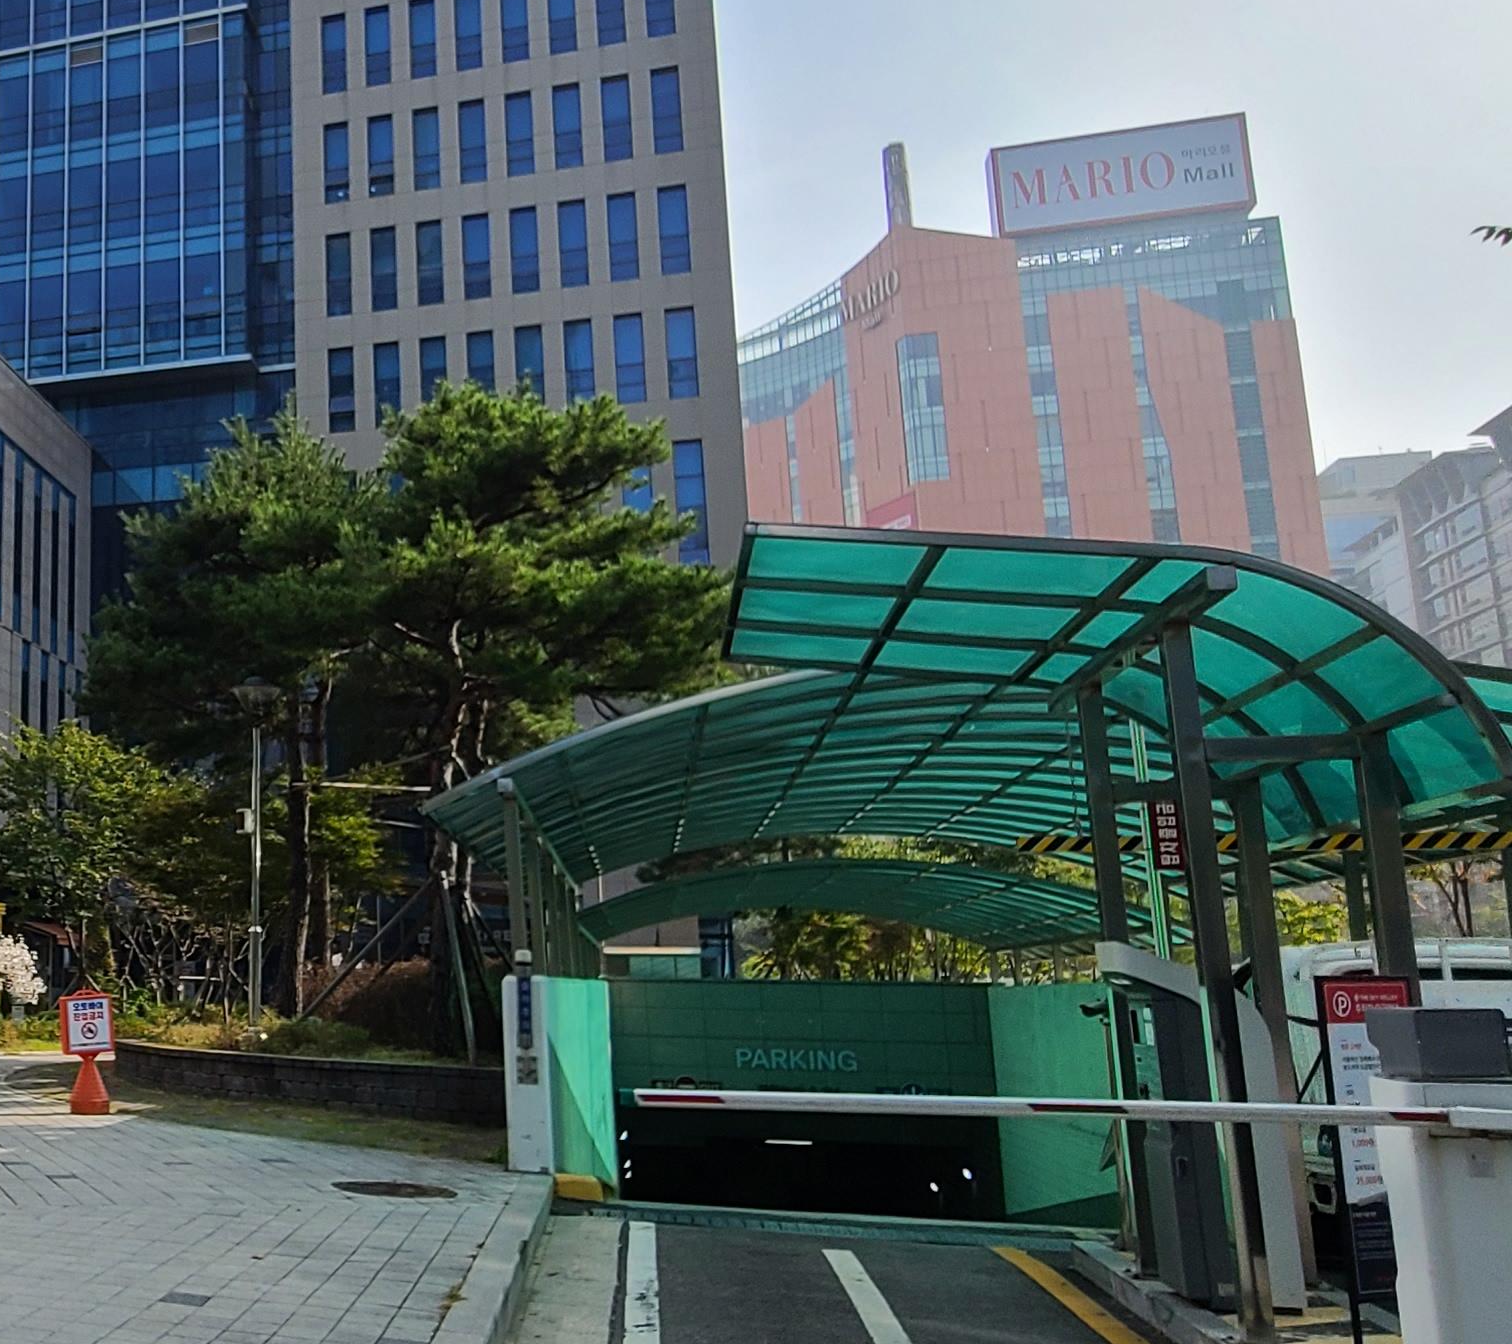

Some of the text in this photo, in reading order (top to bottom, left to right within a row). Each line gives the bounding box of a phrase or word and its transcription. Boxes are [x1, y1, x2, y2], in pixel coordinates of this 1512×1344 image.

[1010, 151, 1235, 209] MARIO Mall
[841, 269, 900, 321] MARIO
[72, 1001, 104, 1012] 오토바이
[734, 1047, 858, 1072] PARKING
